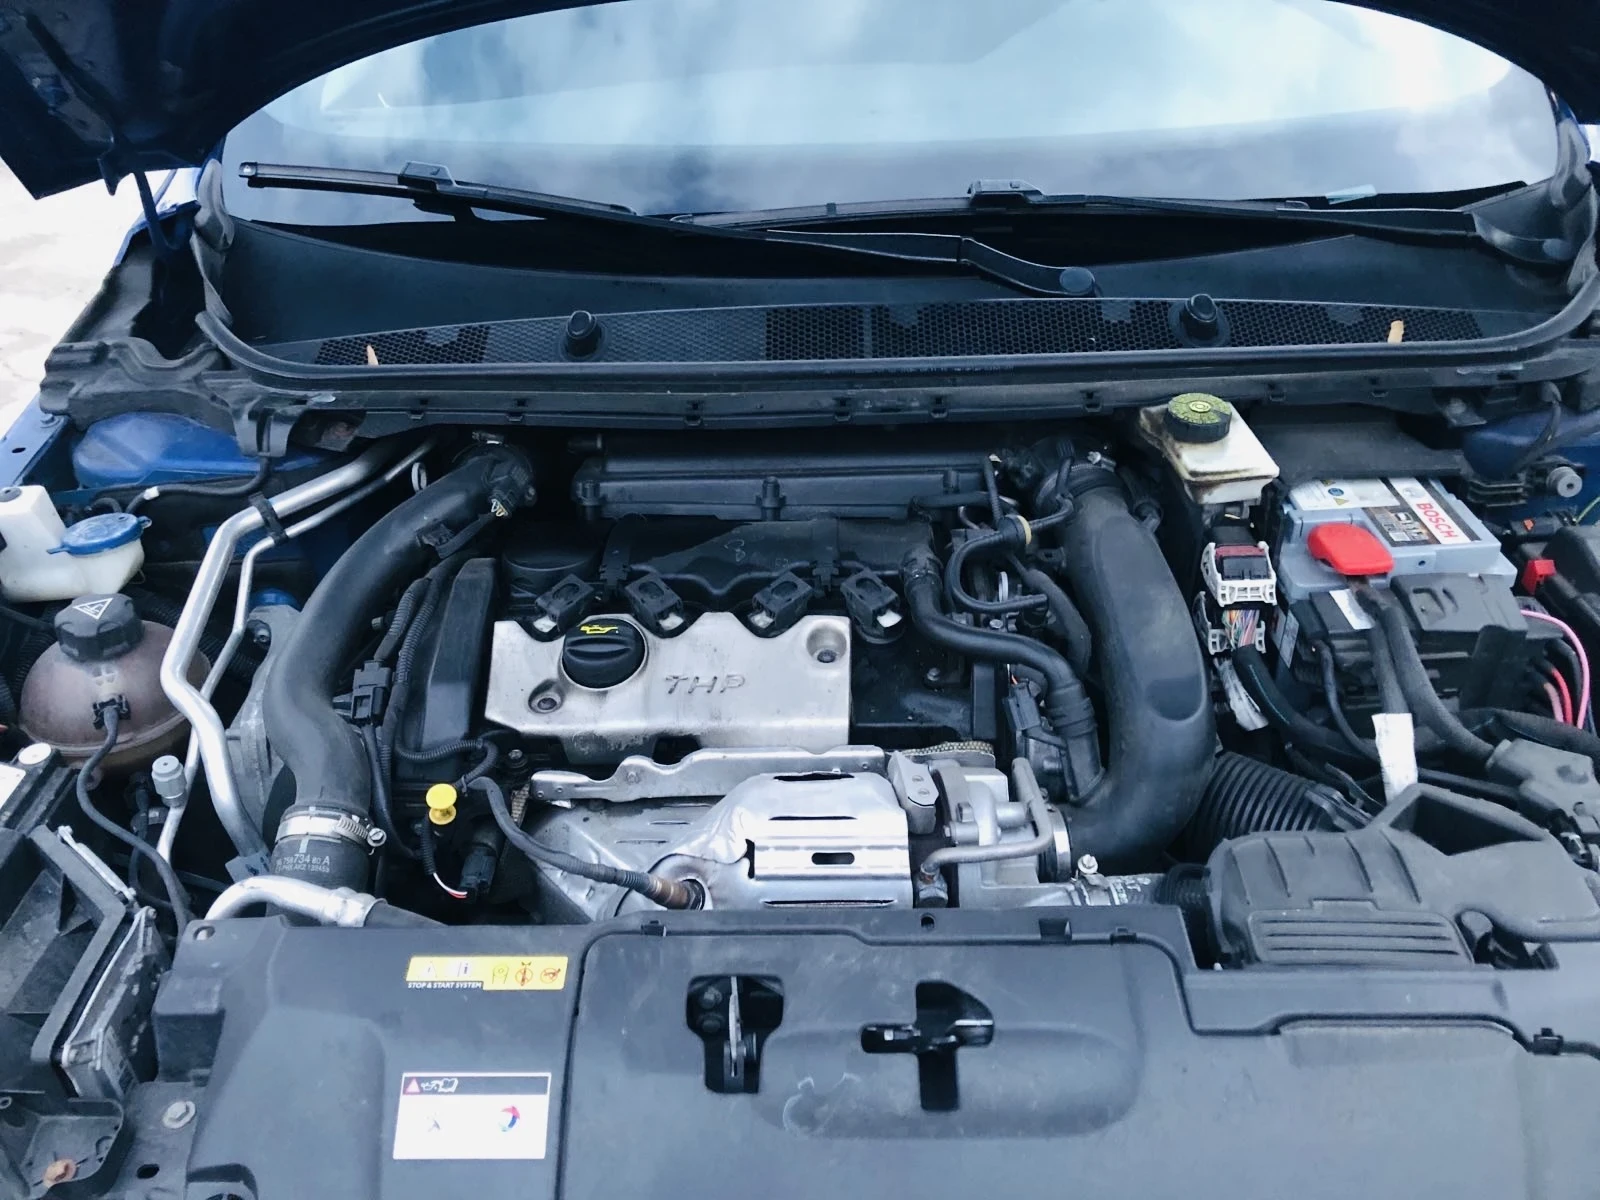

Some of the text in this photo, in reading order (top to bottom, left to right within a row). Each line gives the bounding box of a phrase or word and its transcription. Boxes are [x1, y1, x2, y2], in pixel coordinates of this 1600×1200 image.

[1415, 502, 1459, 538] BOSCH
[665, 674, 746, 694] THP
[407, 981, 482, 989] STOP & START SYSTEM
